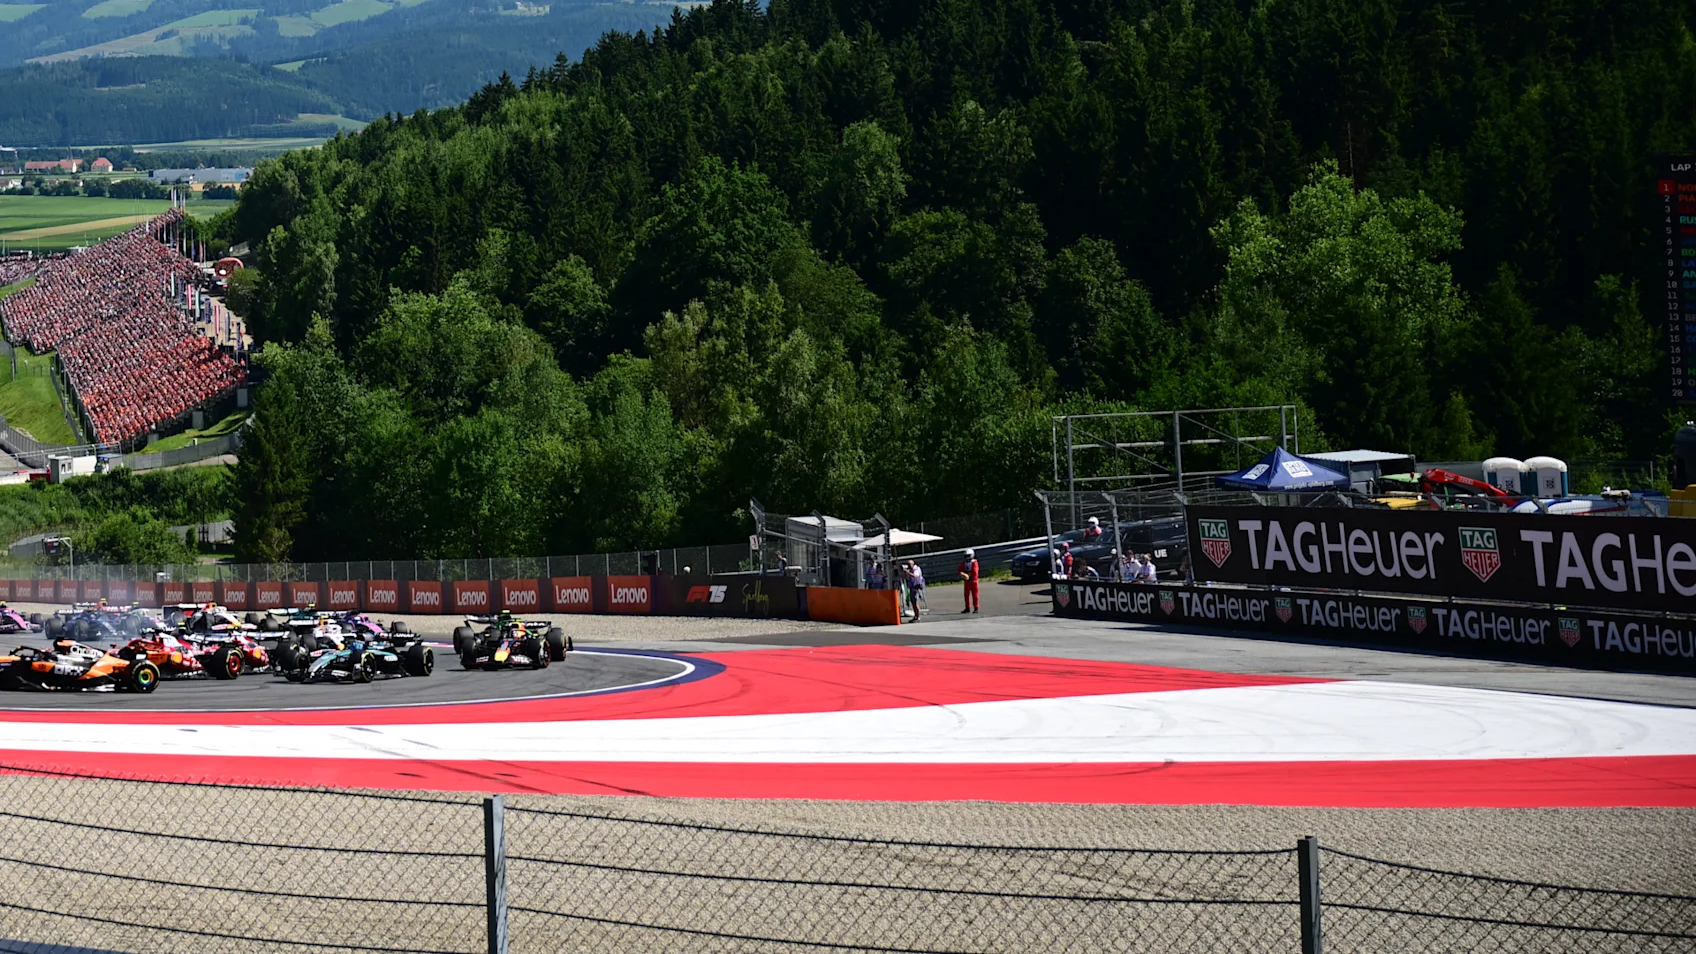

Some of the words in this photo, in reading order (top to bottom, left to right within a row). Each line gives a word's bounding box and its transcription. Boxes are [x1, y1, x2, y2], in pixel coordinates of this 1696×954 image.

[1671, 163, 1691, 172] LAP
[1678, 184, 1696, 192] NO
[1665, 205, 1671, 213] 3
[1666, 227, 1672, 235] 5
[1667, 248, 1673, 256] 7
[1667, 280, 1677, 288] 10
[1668, 302, 1678, 310] 12
[1669, 313, 1679, 321] 13
[1672, 378, 1682, 386] 19
[1673, 389, 1683, 397] 20
[1200, 521, 1227, 538] TAG
[1462, 530, 1495, 549] TAG
[1202, 540, 1230, 563] HEUER
[1238, 520, 1445, 579] TAGHeuer
[1464, 550, 1499, 578] HEUER
[164, 588, 182, 602] Lenovo
[193, 588, 213, 602] Lenovo
[224, 588, 245, 603] Lenovo
[258, 588, 280, 603] Lenovo
[293, 588, 316, 604] Lenovo
[330, 587, 355, 604] Lenovo
[370, 587, 396, 604] Lenovo
[412, 587, 439, 605] Lenovo
[456, 588, 487, 606] Lenovo
[504, 586, 536, 605] Lenovo
[555, 585, 589, 604] Lenovo
[611, 583, 647, 604] Lenovo
[1160, 592, 1173, 601] TAG
[1276, 599, 1291, 608] TAG
[1408, 608, 1425, 618] TAG
[1560, 619, 1579, 630] TAG
[70, 645, 104, 658] Chrome
